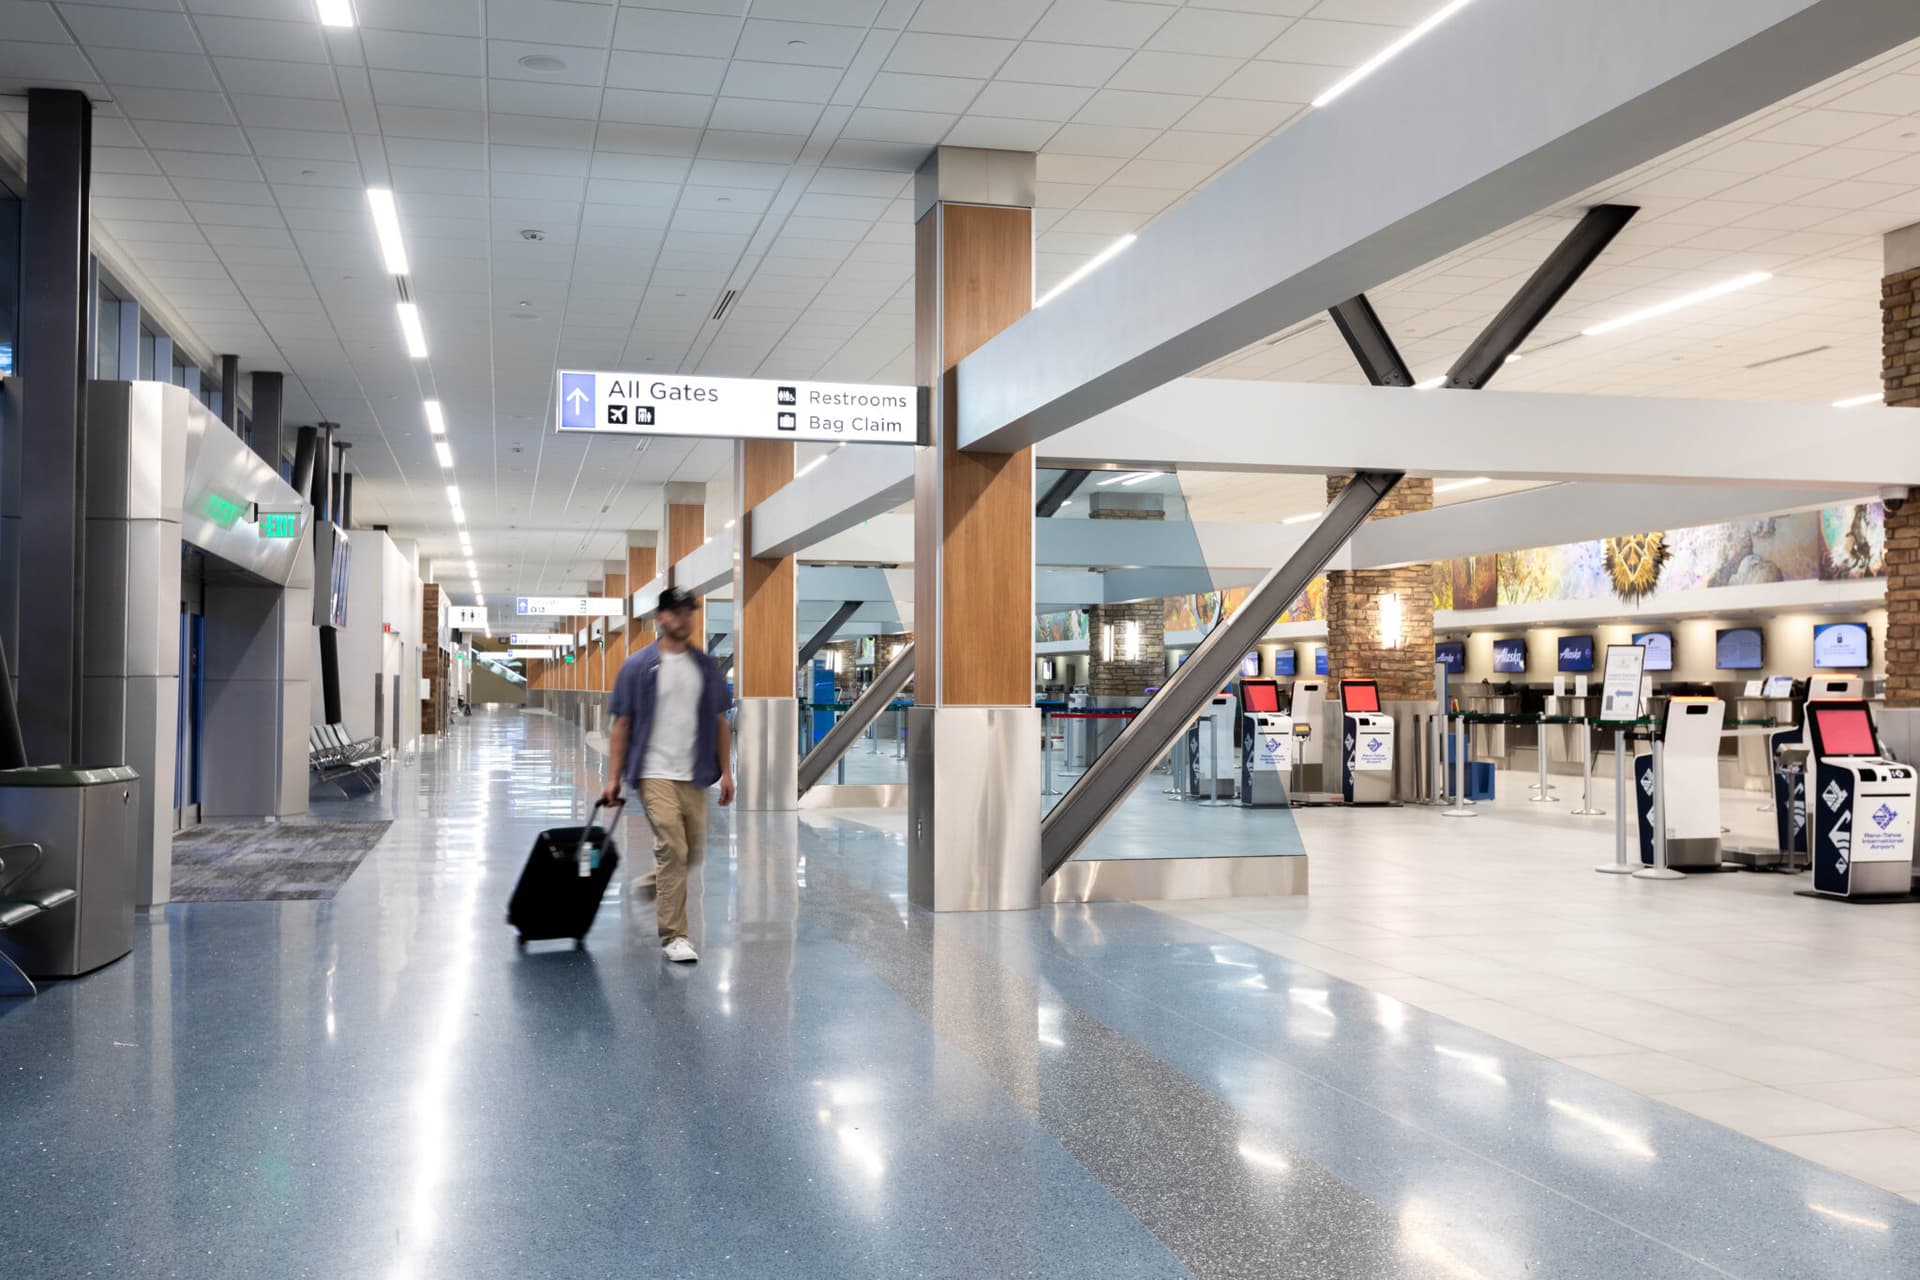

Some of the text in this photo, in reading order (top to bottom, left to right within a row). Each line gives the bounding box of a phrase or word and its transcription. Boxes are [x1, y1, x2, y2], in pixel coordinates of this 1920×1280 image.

[608, 380, 719, 402] All Gates
[809, 390, 907, 408] Restrooms
[809, 415, 902, 433] Bag Claim
[266, 514, 295, 537] EXIT
